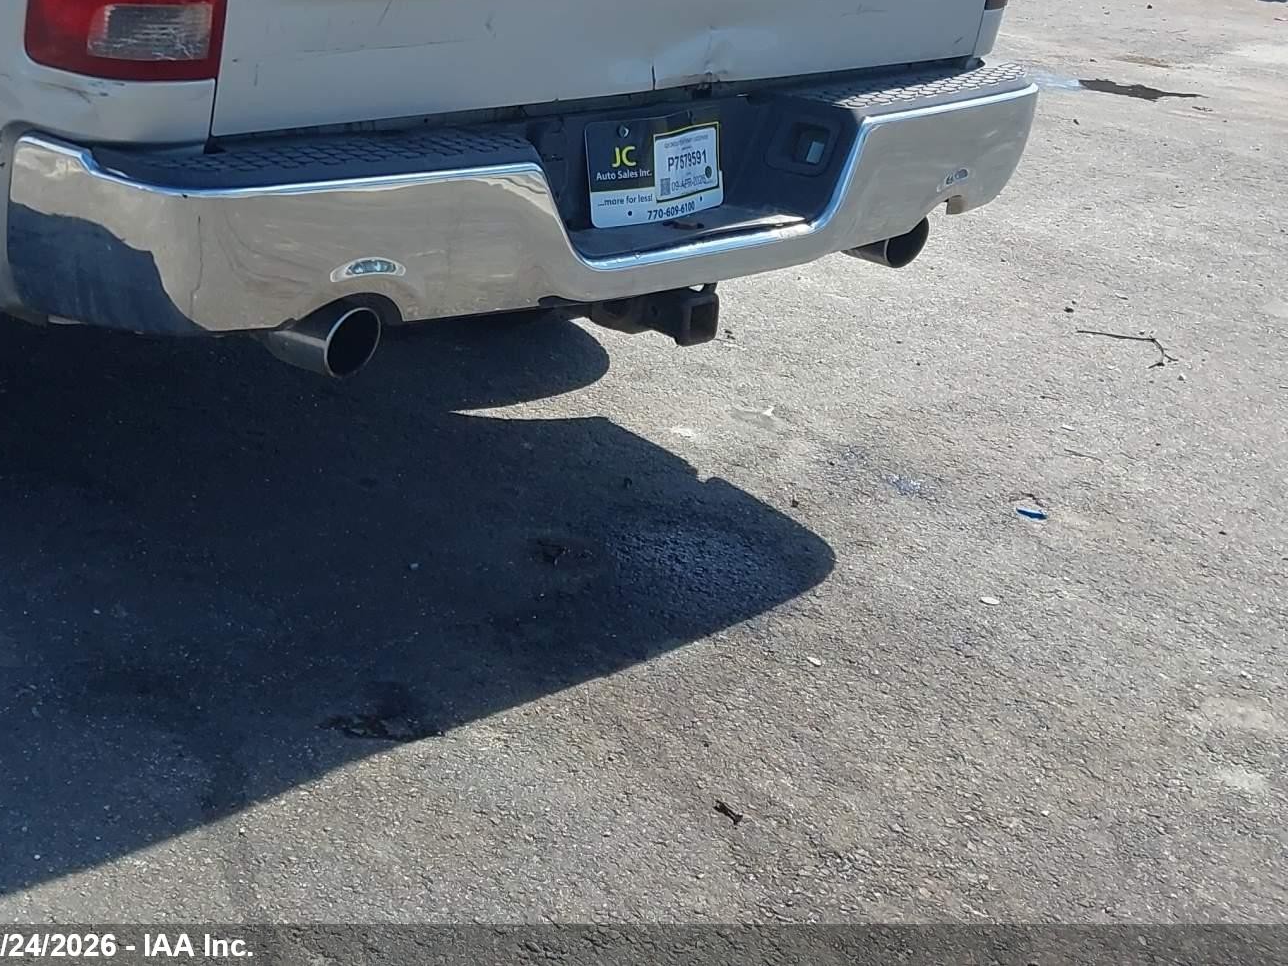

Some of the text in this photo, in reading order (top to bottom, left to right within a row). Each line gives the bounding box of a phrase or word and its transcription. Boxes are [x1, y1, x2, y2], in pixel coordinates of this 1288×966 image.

[612, 145, 637, 168] JC
[595, 168, 653, 181] Auto Sales Inc.
[626, 195, 637, 204] for
[637, 193, 654, 203] less!
[647, 201, 696, 221] 770-609-6100
